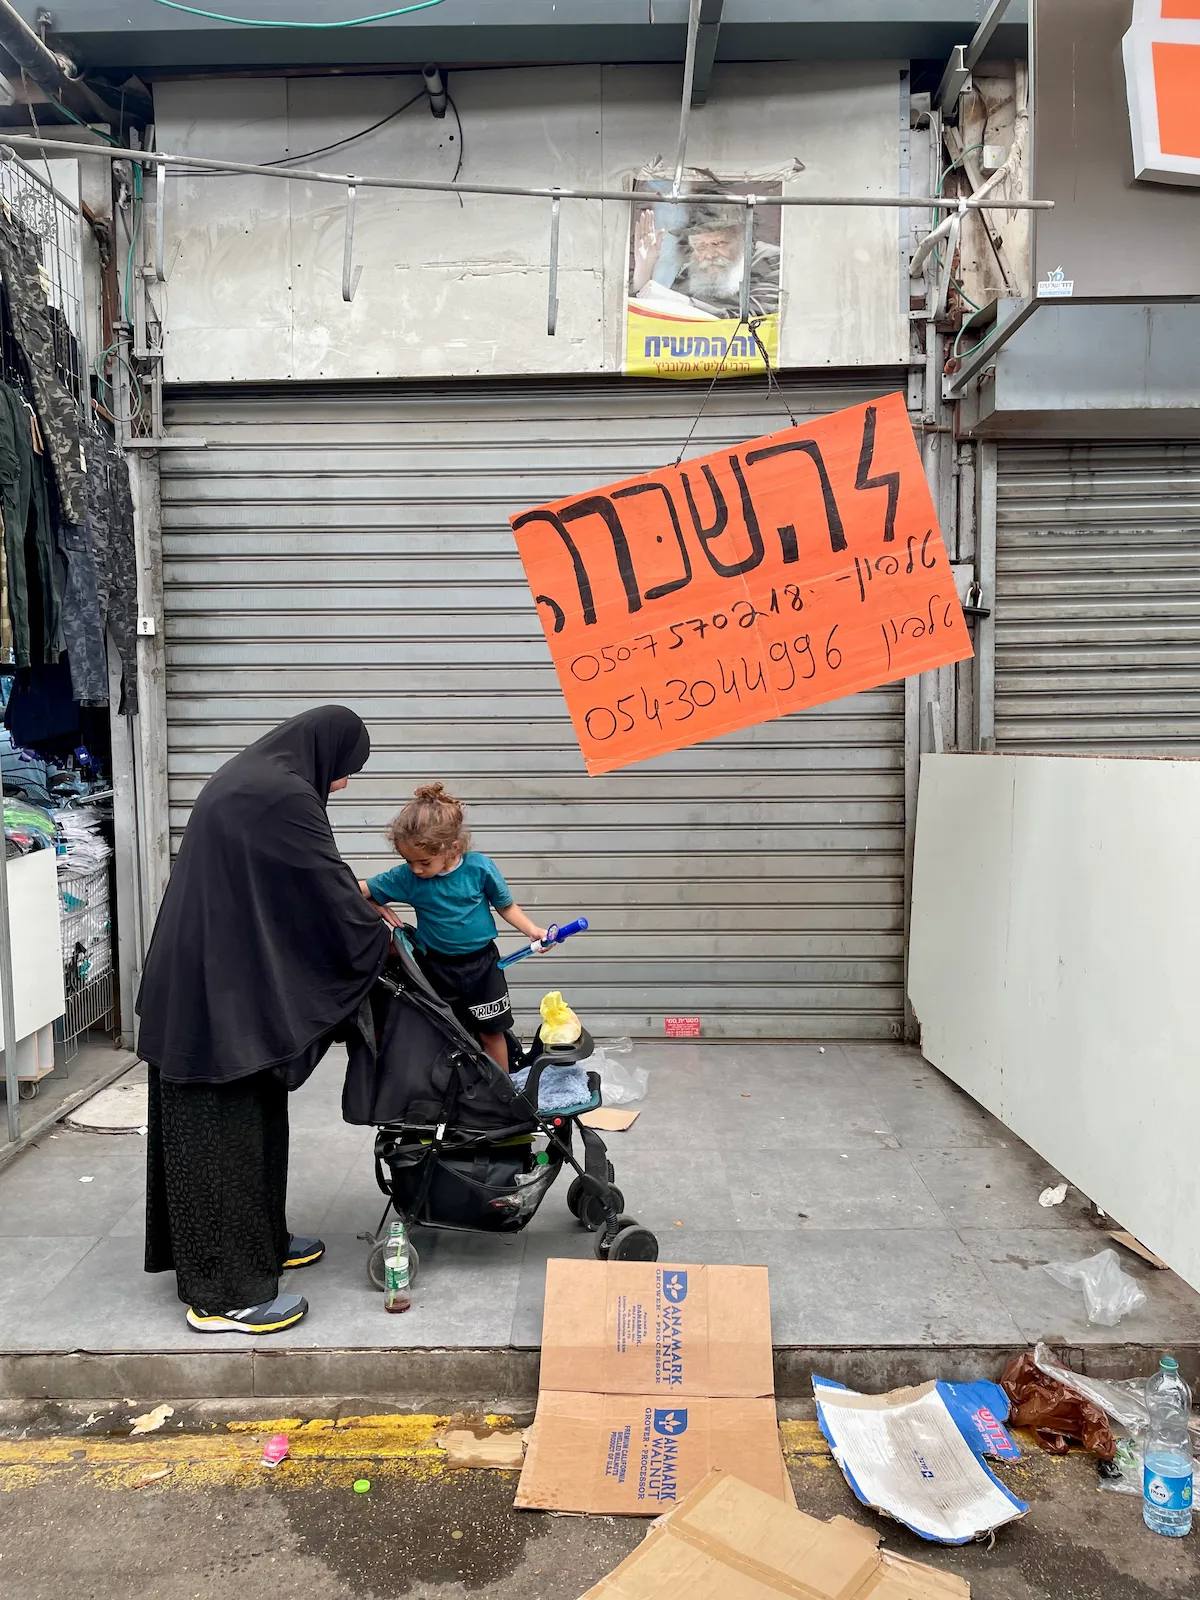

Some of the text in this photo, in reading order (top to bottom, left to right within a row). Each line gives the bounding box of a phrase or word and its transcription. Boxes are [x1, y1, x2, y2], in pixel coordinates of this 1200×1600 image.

[645, 336, 727, 358] המשיח
[730, 362, 750, 371] הרבי
[512, 406, 900, 633] להשכרה
[882, 594, 953, 672] טלפון
[662, 1306, 671, 1384] WALNUT
[608, 1452, 614, 1460] OF
[609, 1431, 617, 1452] PRODUCT
[612, 1431, 623, 1476] SHELLED WALNUTS
[618, 1425, 631, 1483] PREMIUM CALIFORNIA
[638, 1407, 652, 1500] GROWER PROCESSOR
[648, 1437, 663, 1500] WALNUT
